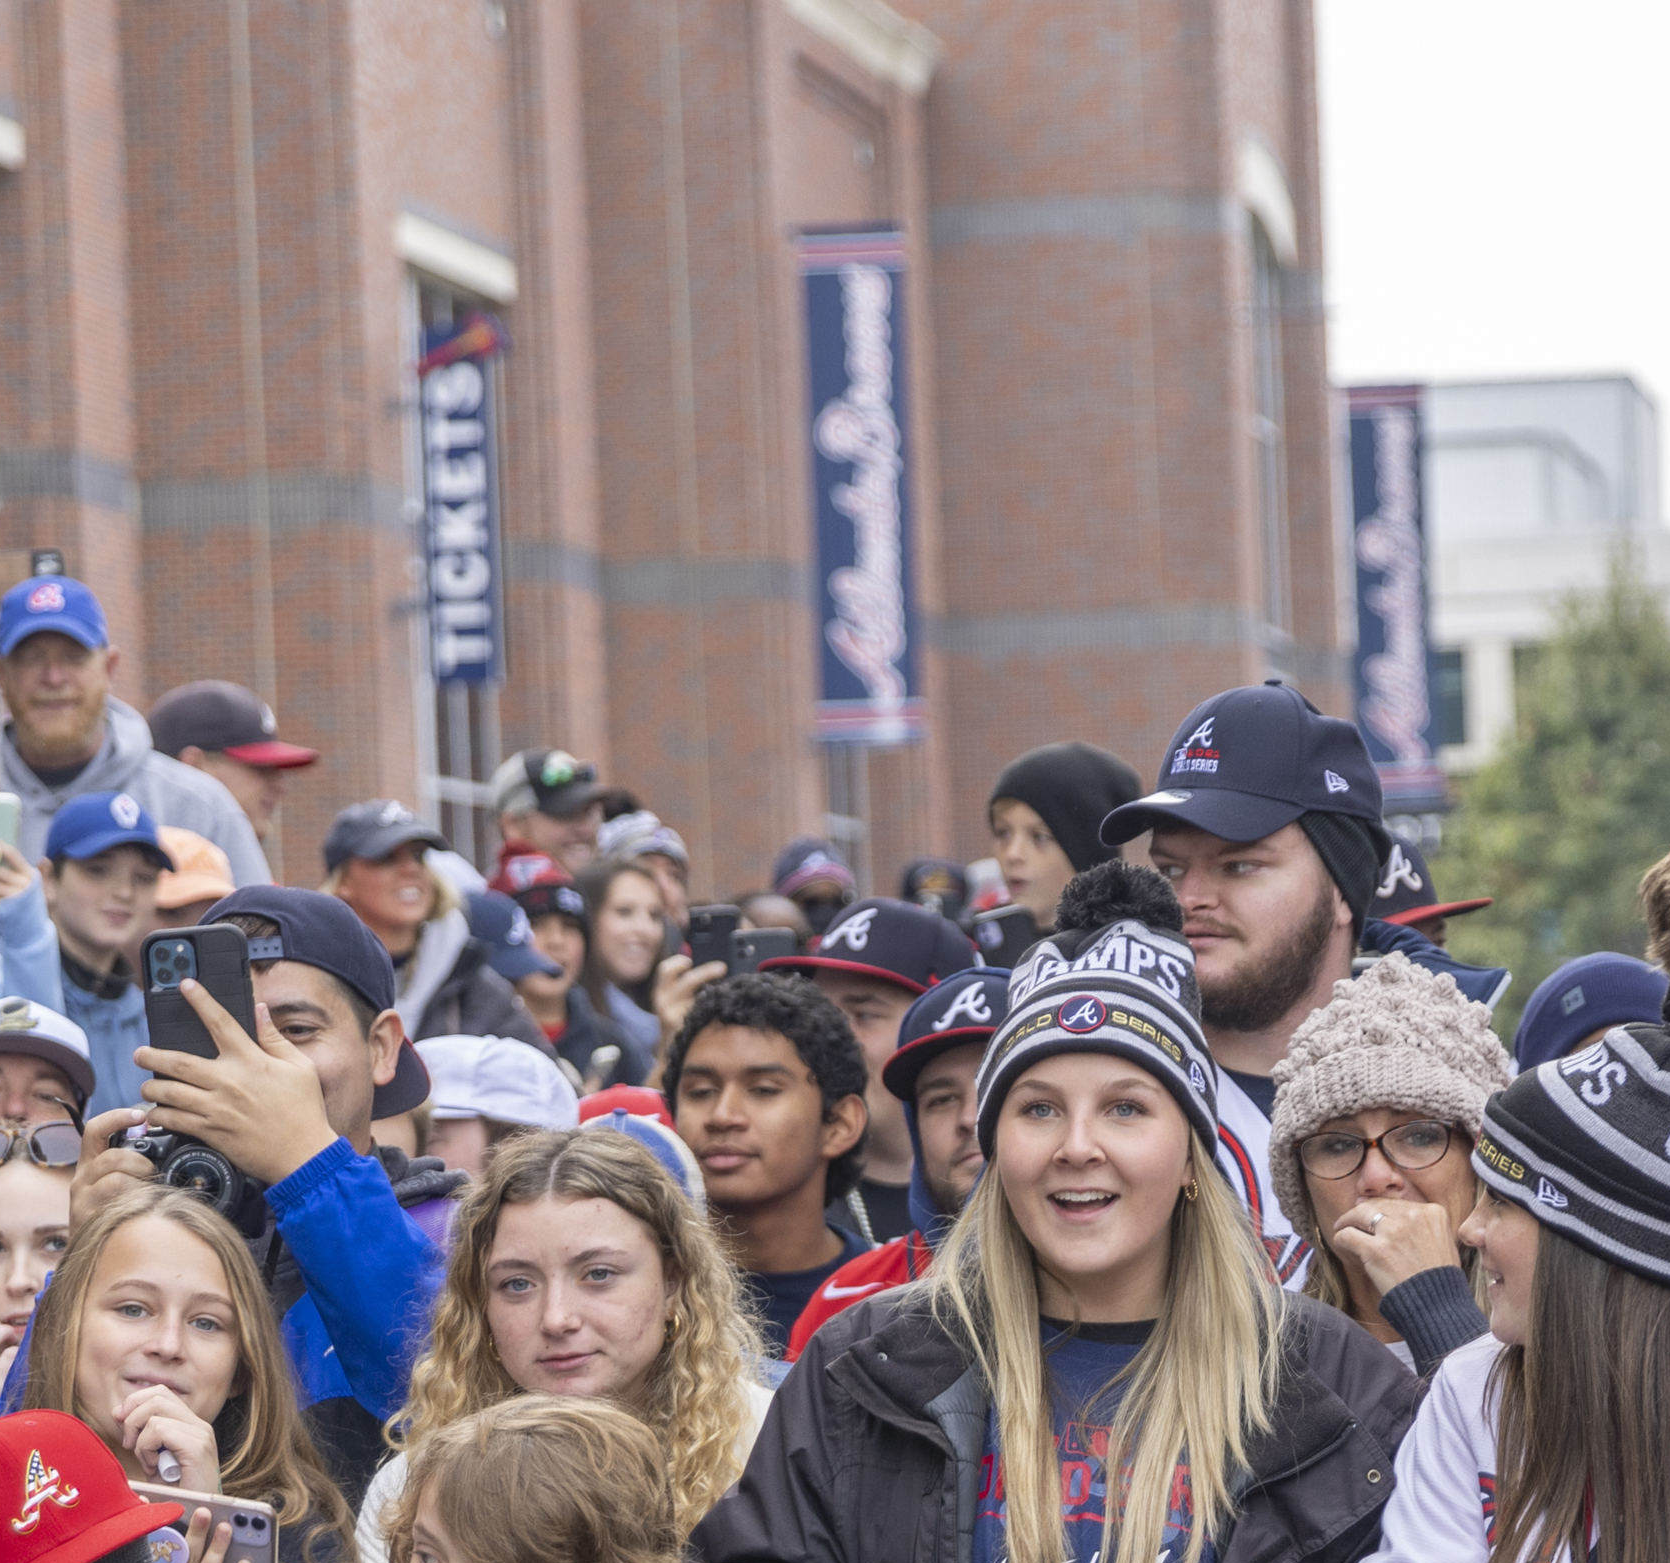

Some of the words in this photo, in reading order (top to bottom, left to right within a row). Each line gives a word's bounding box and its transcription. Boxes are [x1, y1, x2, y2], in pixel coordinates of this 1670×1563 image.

[422, 361, 494, 675] TICKETS
[1183, 716, 1215, 748] A
[1190, 759, 1220, 775] SERIES
[1376, 844, 1422, 897] A
[821, 908, 878, 950] A
[932, 981, 991, 1031] A
[1063, 999, 1097, 1025] A
[1111, 1010, 1182, 1062] SERIES
[11, 1448, 80, 1535] A
